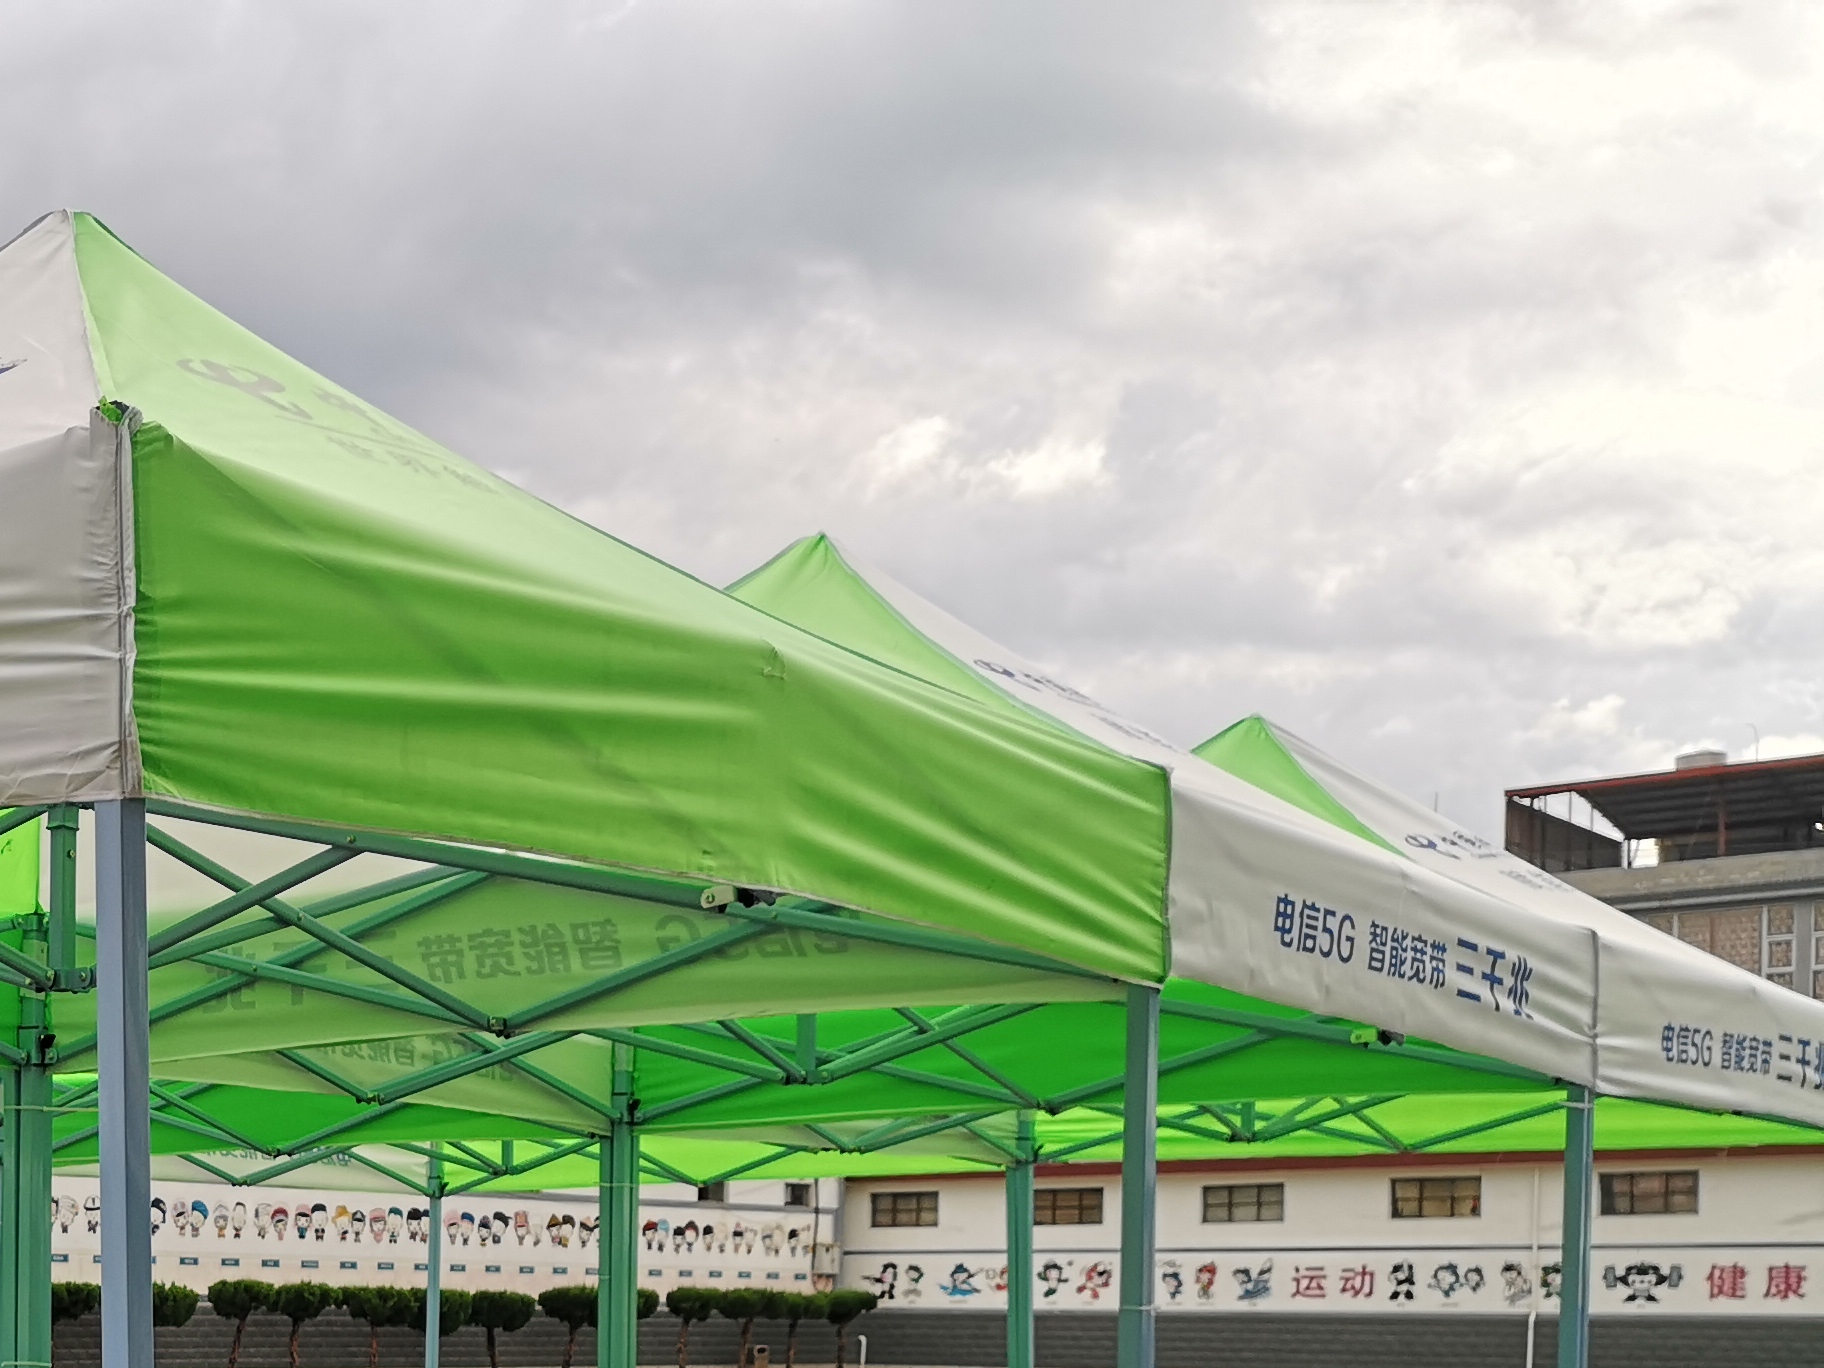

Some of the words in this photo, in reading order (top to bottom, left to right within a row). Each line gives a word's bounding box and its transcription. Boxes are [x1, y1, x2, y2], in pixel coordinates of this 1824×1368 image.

[1274, 893, 1356, 966] 电信5G
[1367, 919, 1448, 991] 智能宽带
[1455, 936, 1535, 1020] 三千兆
[1661, 1021, 1714, 1068] 电信5G
[1721, 1031, 1773, 1075] 智能宽带
[1290, 1263, 1376, 1299] 运动
[1705, 1261, 1807, 1300] 健康
